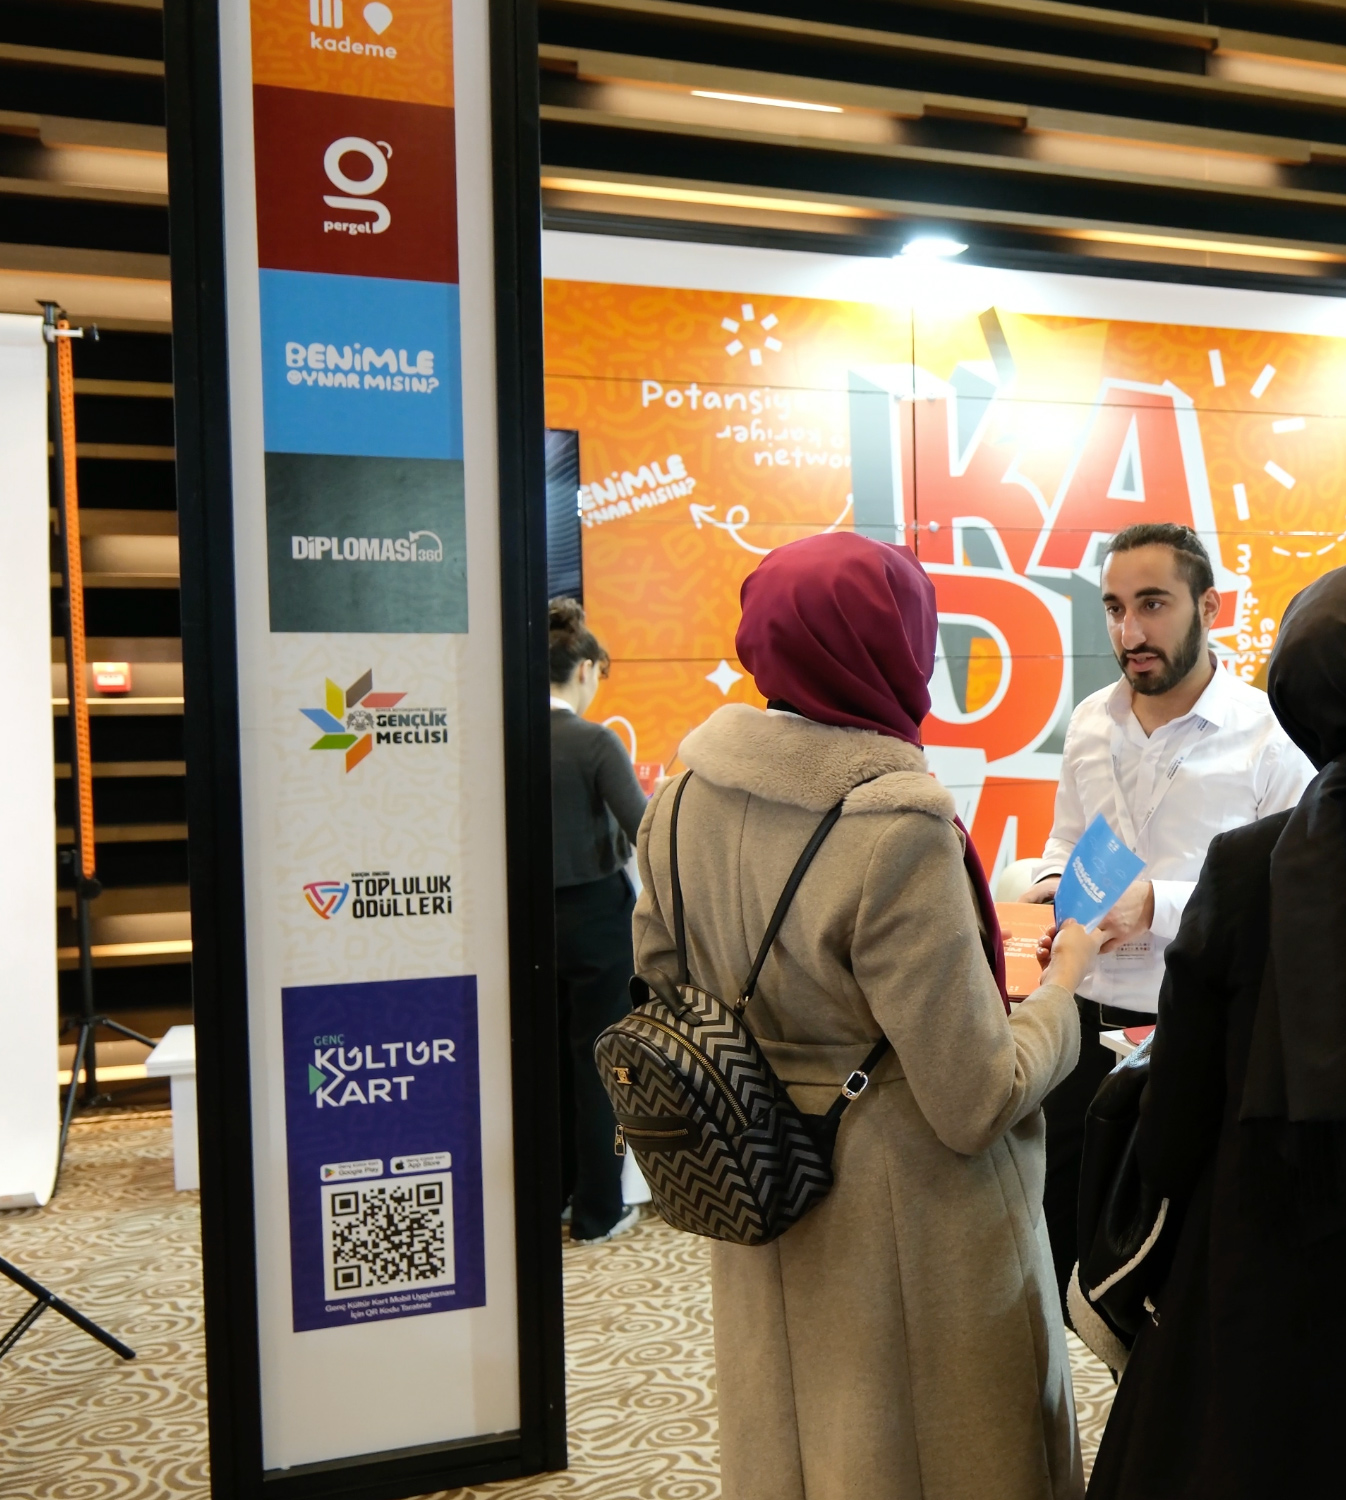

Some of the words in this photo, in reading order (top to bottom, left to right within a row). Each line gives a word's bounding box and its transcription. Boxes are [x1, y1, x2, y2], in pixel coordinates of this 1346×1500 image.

[310, 32, 397, 59] kademe
[323, 218, 371, 235] pergel
[364, 374, 439, 394] MISIN?
[631, 477, 696, 512] MISIN?
[418, 549, 443, 562] 360
[376, 709, 447, 729] GENÇLİK
[376, 729, 448, 744] MECLİSİ
[352, 875, 451, 897] TOPLULUK
[313, 1034, 345, 1046] GENÇ
[316, 1075, 415, 1109] KART
[365, 1308, 378, 1316] QR
